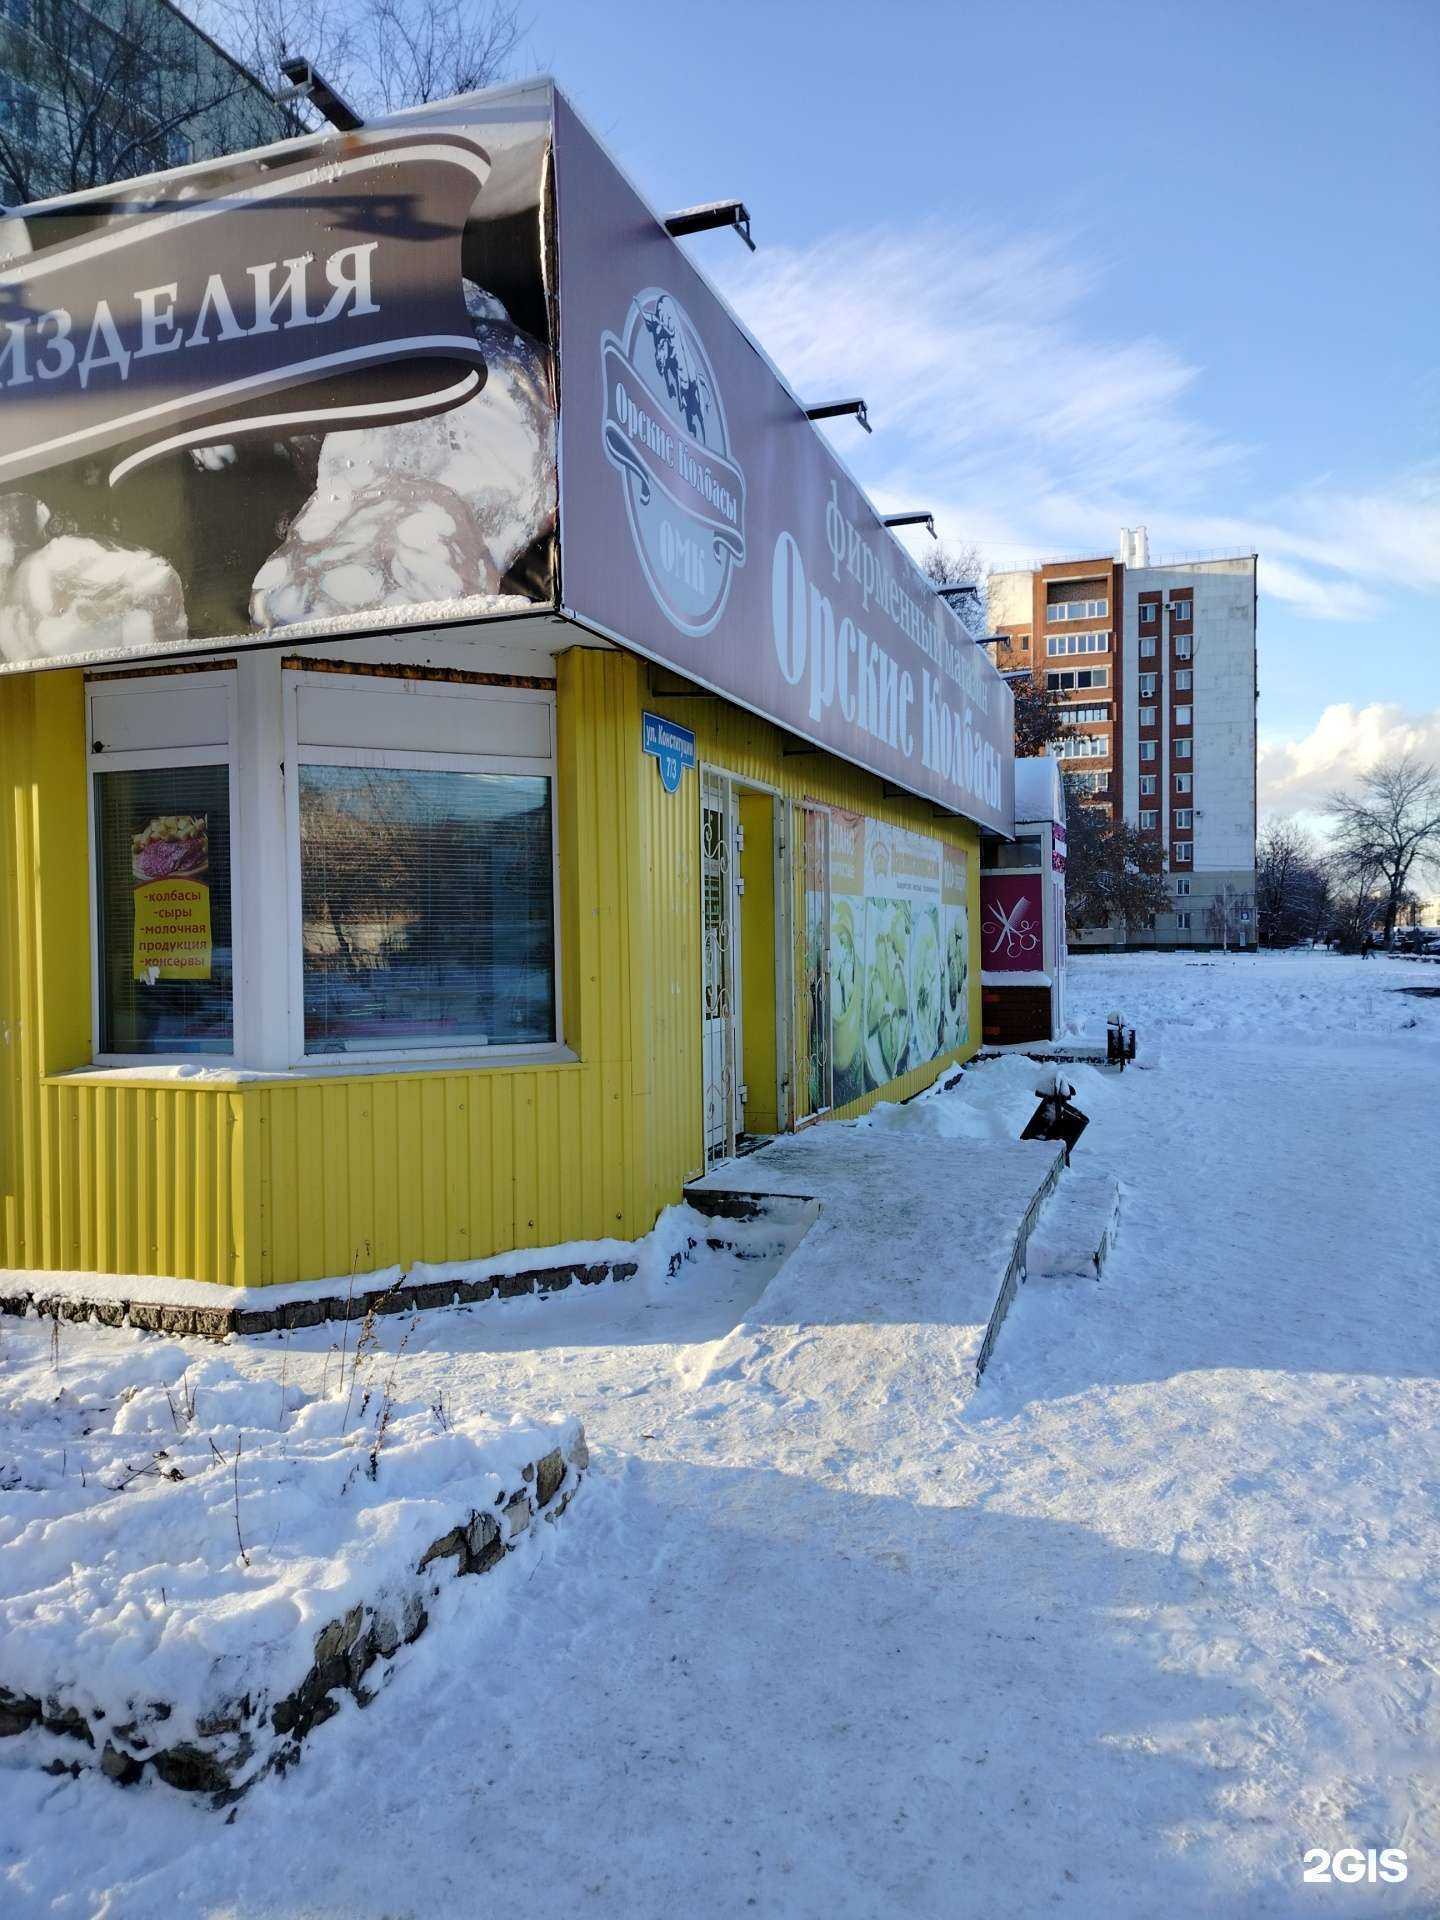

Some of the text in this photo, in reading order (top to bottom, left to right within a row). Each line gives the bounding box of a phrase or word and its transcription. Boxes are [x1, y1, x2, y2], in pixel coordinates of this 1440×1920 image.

[615, 382, 737, 524] Орские Колбасы
[659, 519, 705, 595] ОМК
[772, 531, 1002, 812] Орские Колбасы
[646, 725, 694, 758] ул. Конституции
[666, 756, 677, 779] 7/3
[143, 889, 201, 902] -колбасы
[153, 907, 192, 919] -сыры
[140, 923, 206, 935] -молочная
[139, 939, 207, 952] продукция
